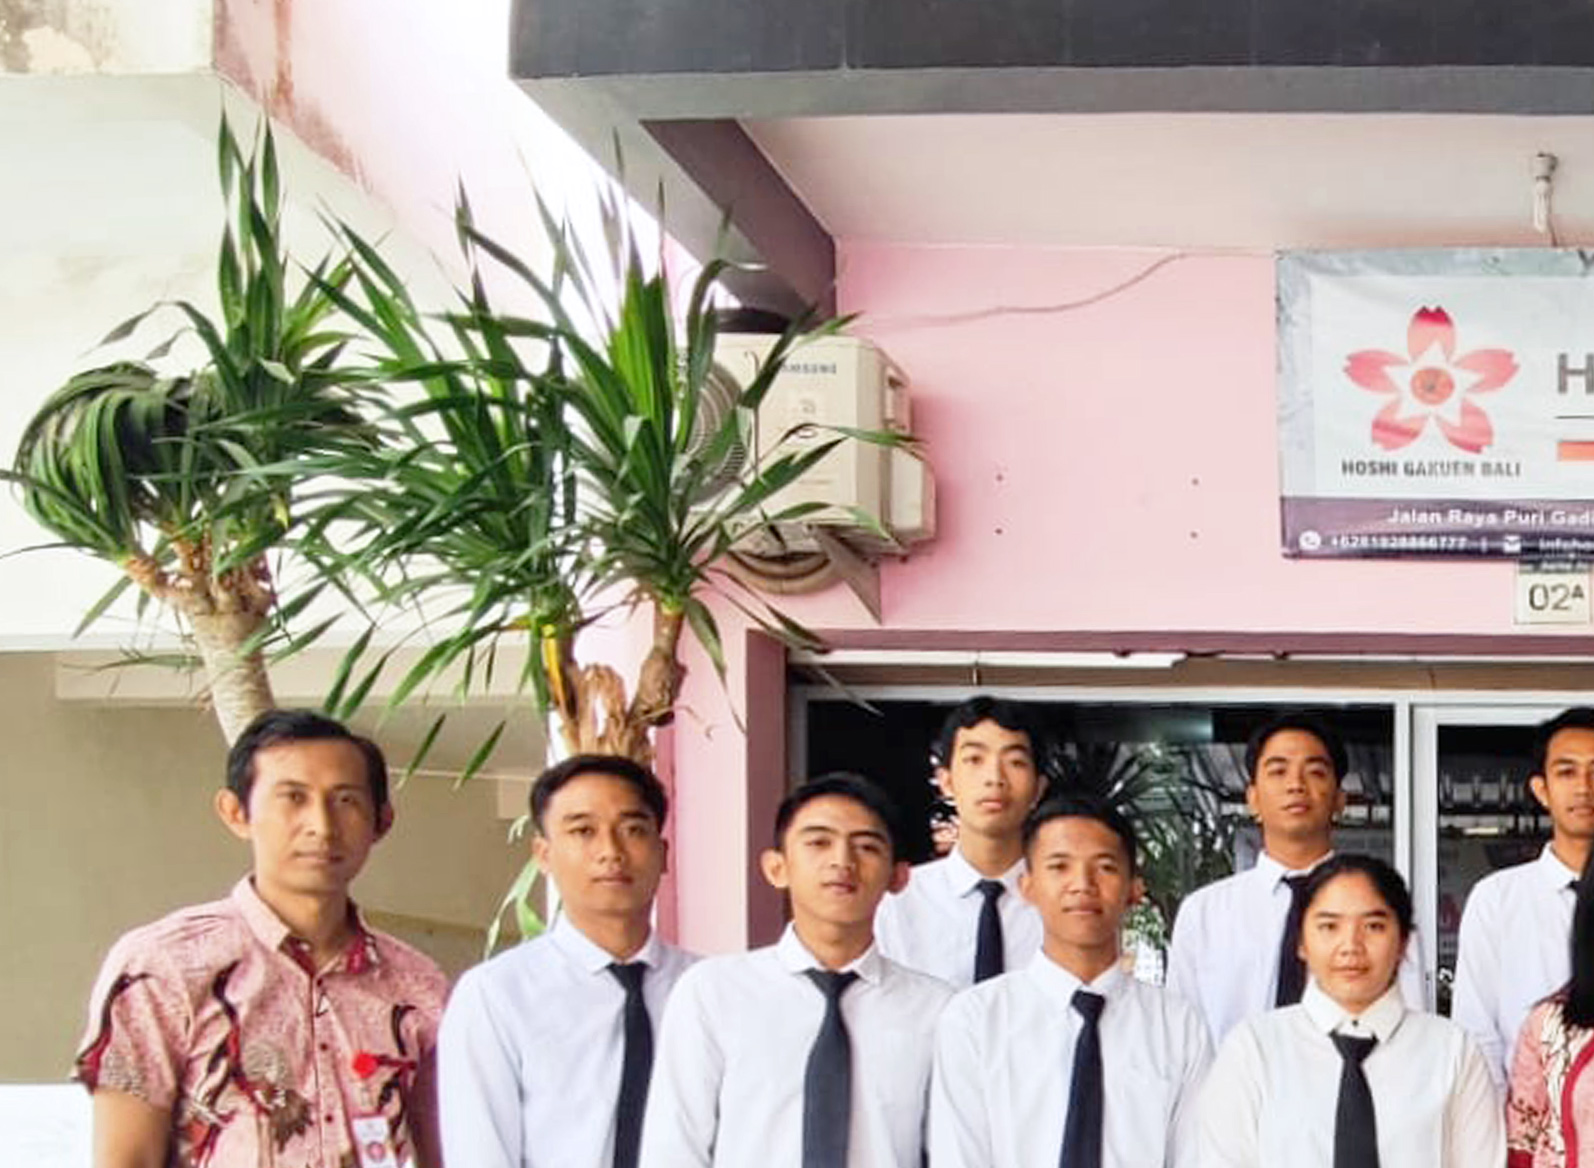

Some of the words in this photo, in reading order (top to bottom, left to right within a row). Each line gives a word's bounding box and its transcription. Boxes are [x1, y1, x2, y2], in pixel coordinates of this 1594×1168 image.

[1341, 460, 1398, 476] HOSHI
[1403, 461, 1475, 477] GAKUEN
[1481, 462, 1521, 477] BALI
[1387, 508, 1442, 524] Jalan
[1448, 509, 1498, 528] Raya
[1504, 509, 1545, 525] Puri
